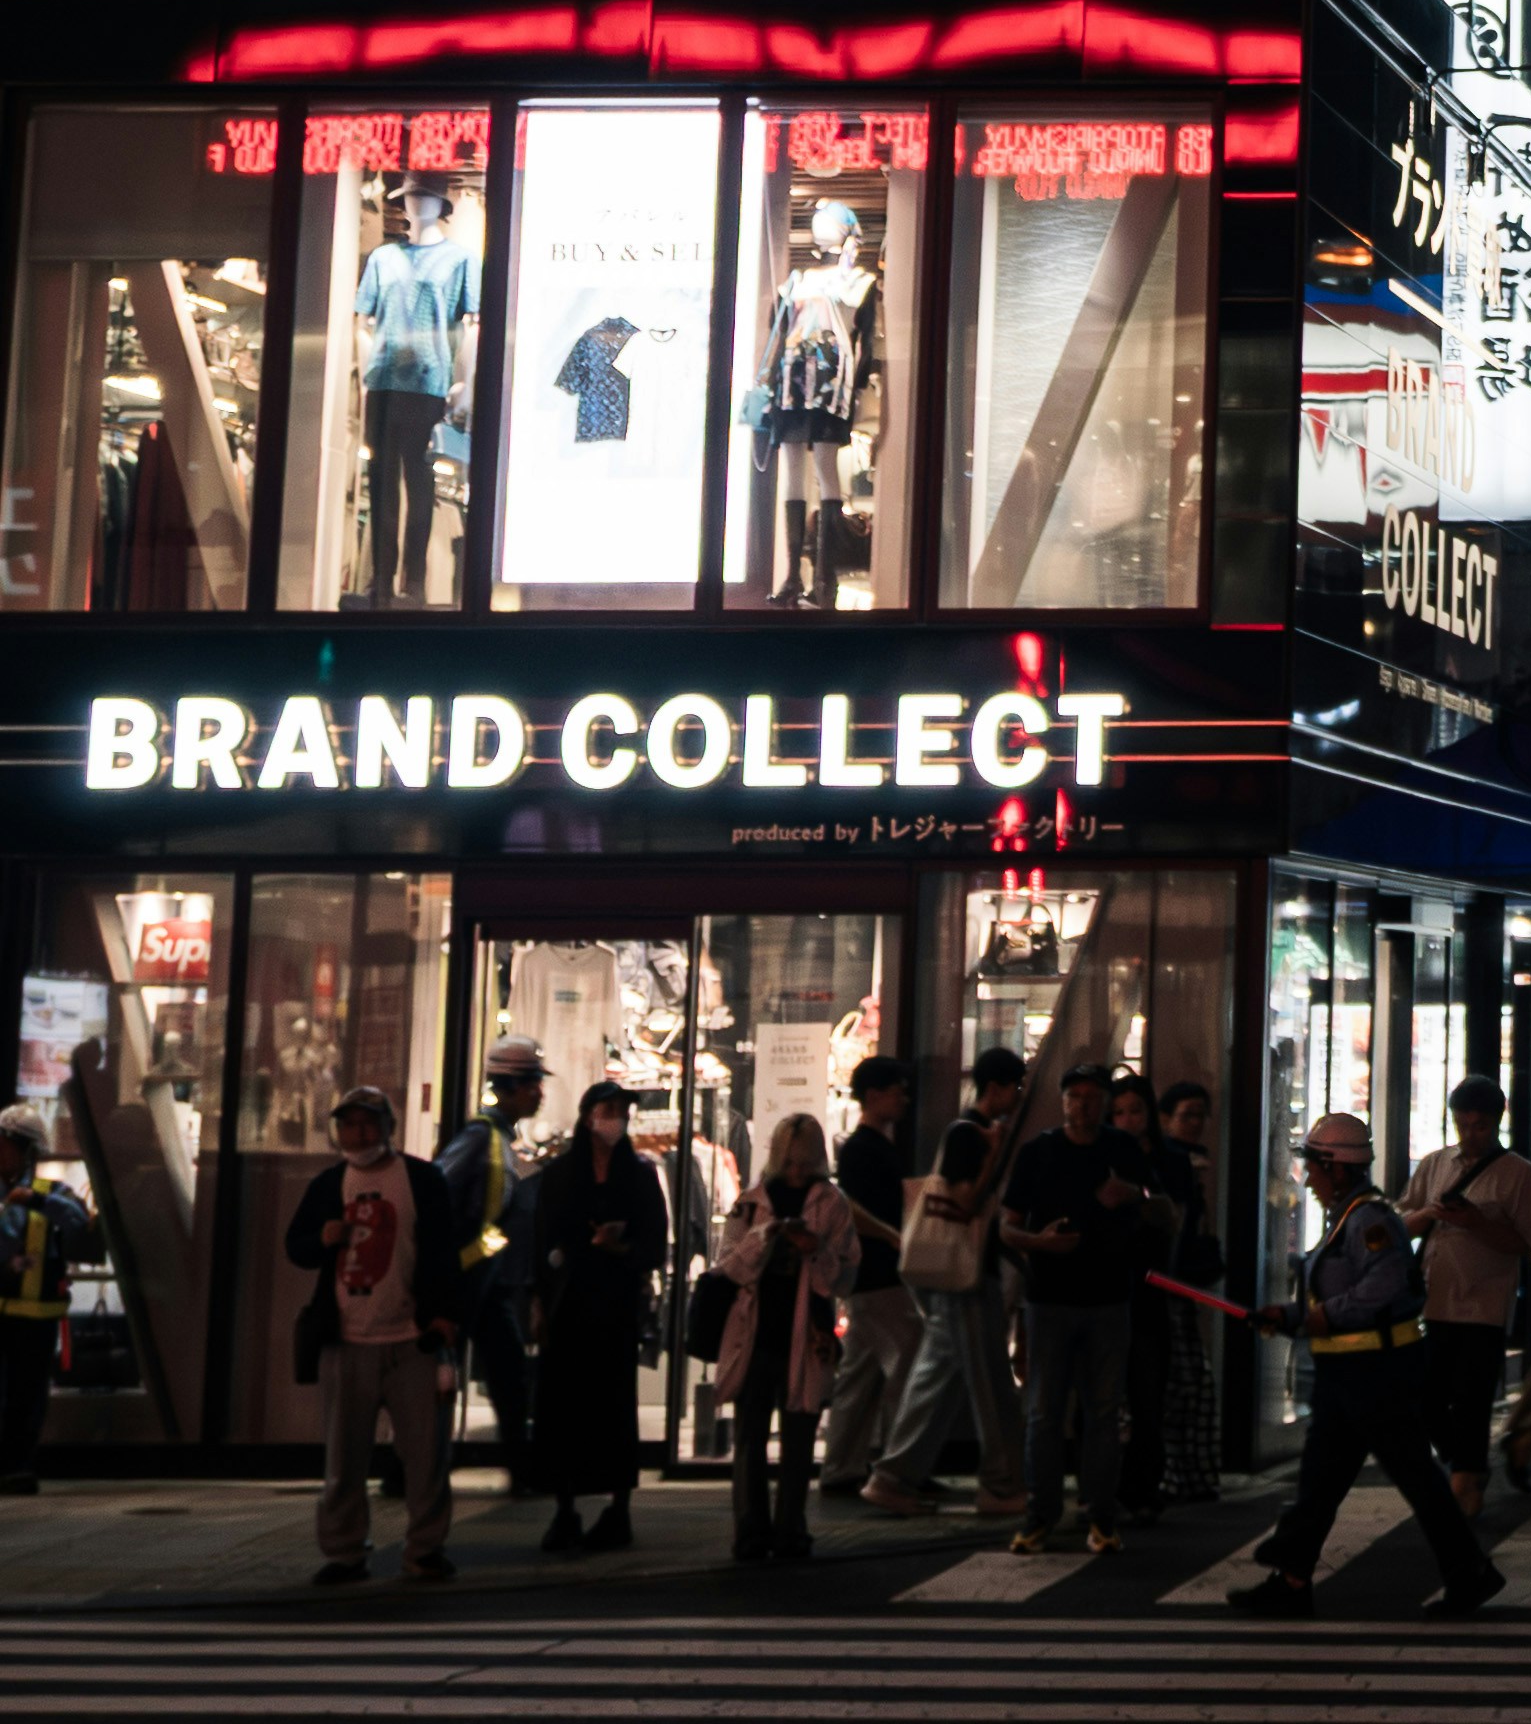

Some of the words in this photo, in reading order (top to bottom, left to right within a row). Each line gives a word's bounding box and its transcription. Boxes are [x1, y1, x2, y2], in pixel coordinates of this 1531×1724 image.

[551, 243, 612, 262] BUY
[651, 243, 713, 262] SEL
[1386, 345, 1475, 493] BRAND
[1382, 502, 1498, 651] COLLECT
[84, 694, 528, 791] BRAND
[560, 692, 1127, 790] COLLECT
[732, 824, 825, 844] produced
[835, 824, 860, 845] by
[141, 927, 211, 973] Sup
